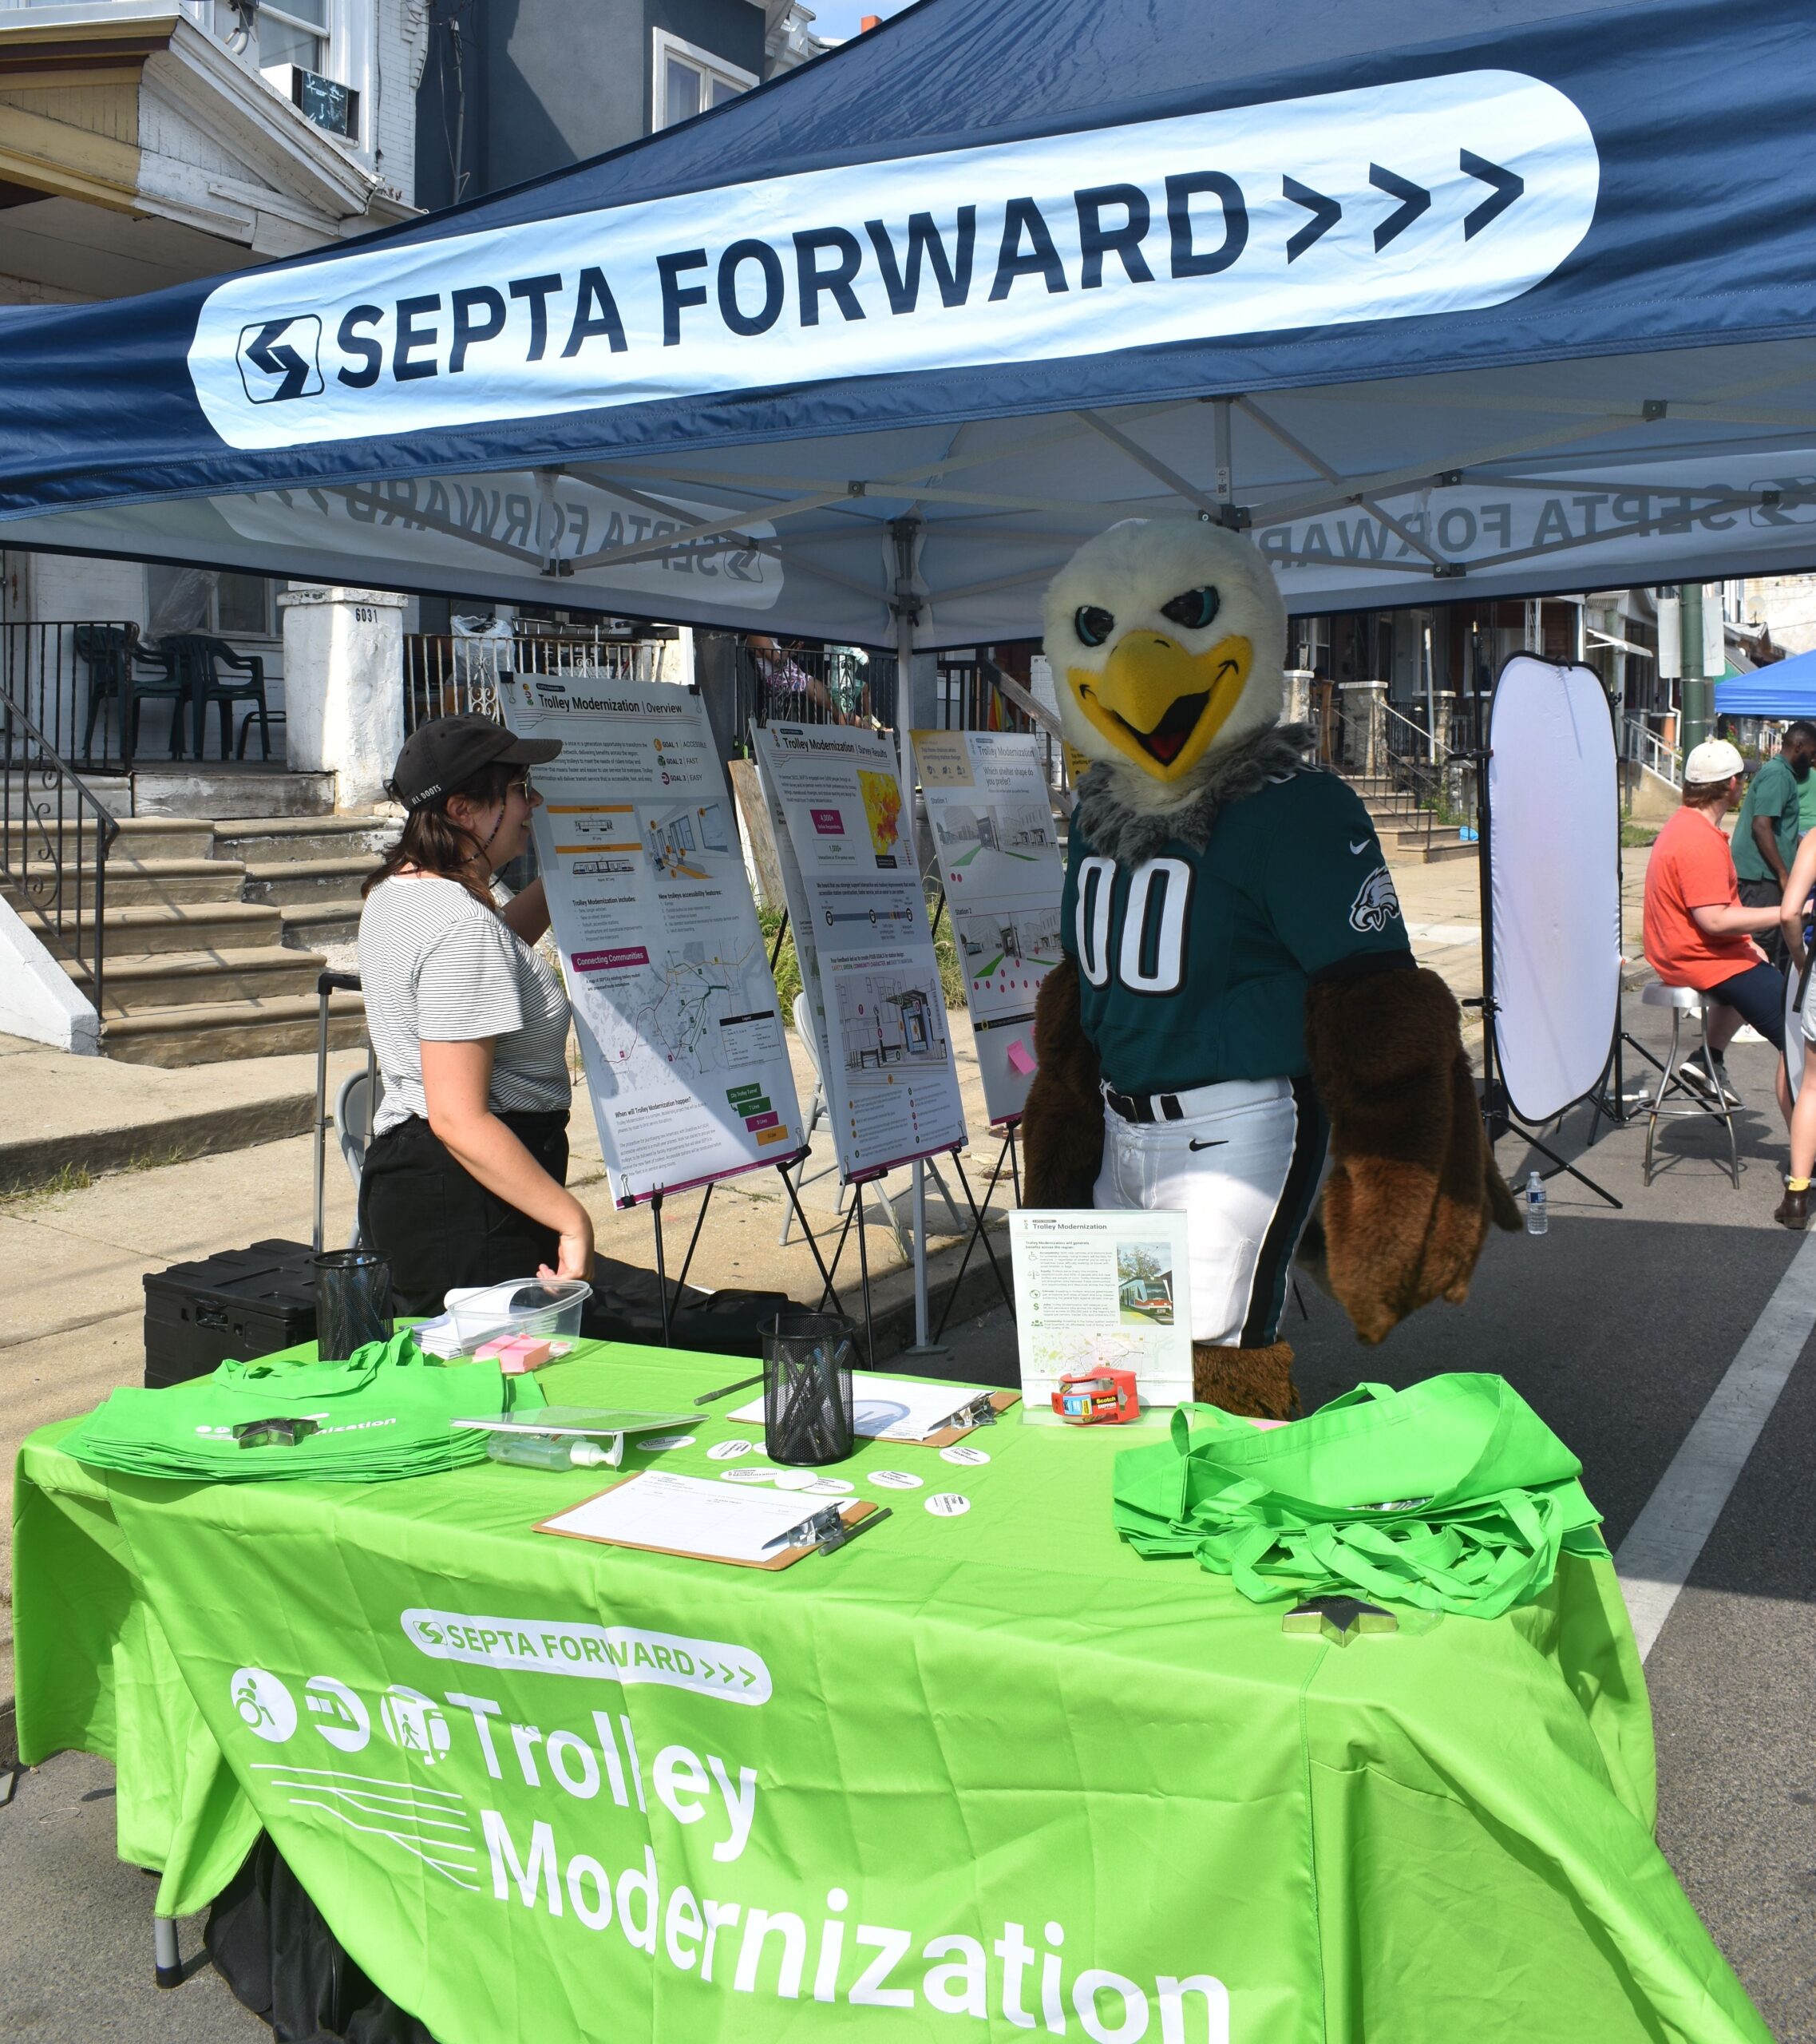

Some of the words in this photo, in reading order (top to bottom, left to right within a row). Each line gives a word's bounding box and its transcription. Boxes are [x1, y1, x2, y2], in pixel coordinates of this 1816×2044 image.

[337, 267, 628, 389] SEPTA
[657, 171, 1249, 347] FORWARD
[356, 608, 378, 623] 6031
[538, 694, 569, 712] Trolley
[572, 697, 639, 712] Modernization
[647, 703, 682, 714] Overview
[782, 738, 809, 752] Trolley
[809, 739, 854, 752] Modernization
[858, 744, 872, 757] Survey
[978, 746, 997, 757] Trolley
[998, 747, 1035, 758] Modernization
[983, 766, 999, 775] Which
[999, 766, 1014, 776] shelter
[1015, 767, 1027, 778] shape
[995, 778, 1010, 786] prefer?
[412, 796, 421, 805] ILL
[421, 784, 441, 798] DOOTS
[1075, 857, 1192, 993] 00
[576, 955, 607, 966] Connecting
[608, 951, 643, 964] Communities
[648, 1101, 675, 1111] Modernization
[675, 1096, 691, 1105] happen?
[445, 1624, 536, 1657] SEPTA
[542, 1634, 695, 1677] FORWARD
[444, 1691, 758, 1863] Trolley
[480, 1809, 1229, 2044] Modernization
